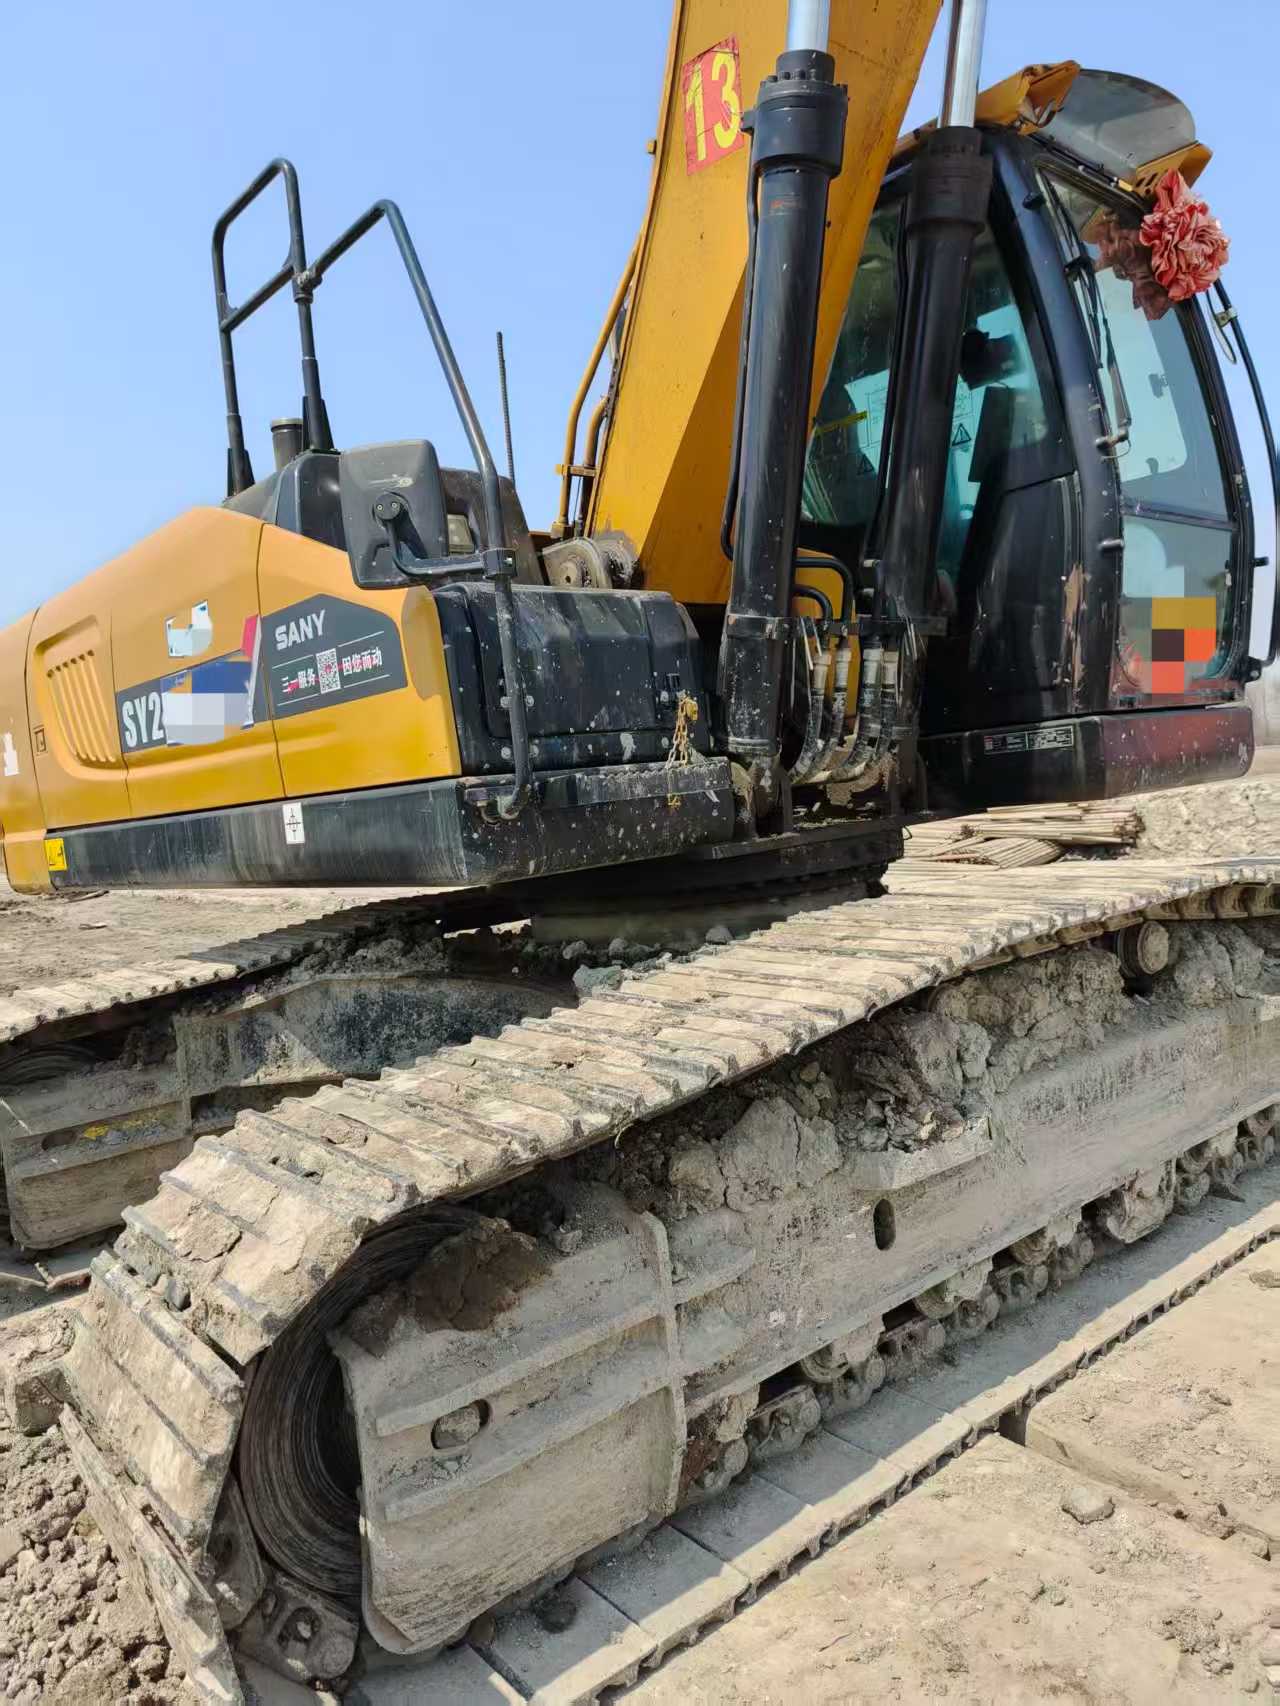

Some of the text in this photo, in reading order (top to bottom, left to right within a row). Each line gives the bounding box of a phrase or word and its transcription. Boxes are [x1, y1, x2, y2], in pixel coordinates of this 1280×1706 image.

[686, 49, 741, 161] 13
[275, 609, 326, 651] SANY
[281, 668, 315, 692] 三一服务
